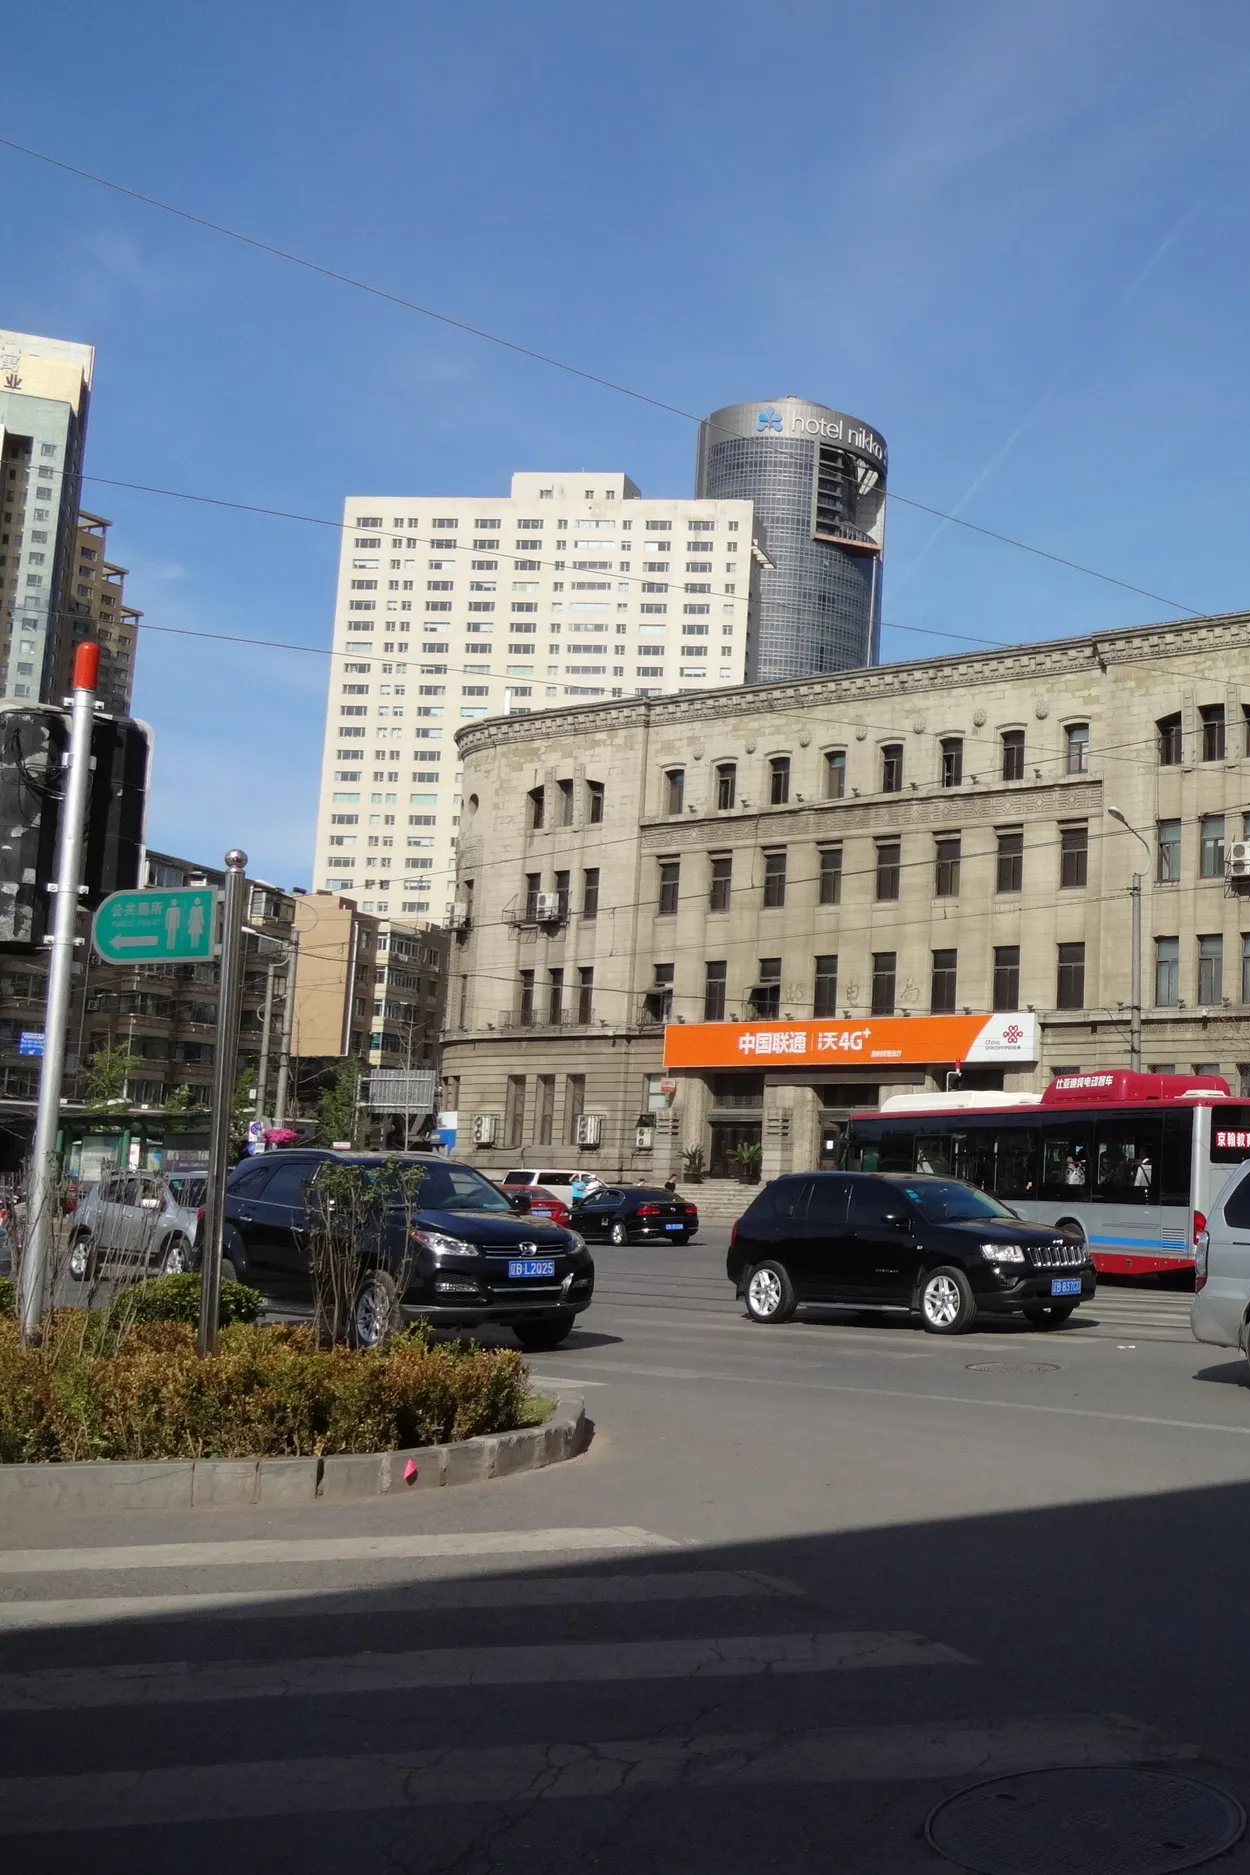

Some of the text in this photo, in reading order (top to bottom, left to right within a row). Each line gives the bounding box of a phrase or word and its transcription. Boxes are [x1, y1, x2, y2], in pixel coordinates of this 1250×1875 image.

[791, 410, 843, 440] hotel
[848, 428, 883, 460] nikko
[738, 1031, 807, 1054] 中国联通
